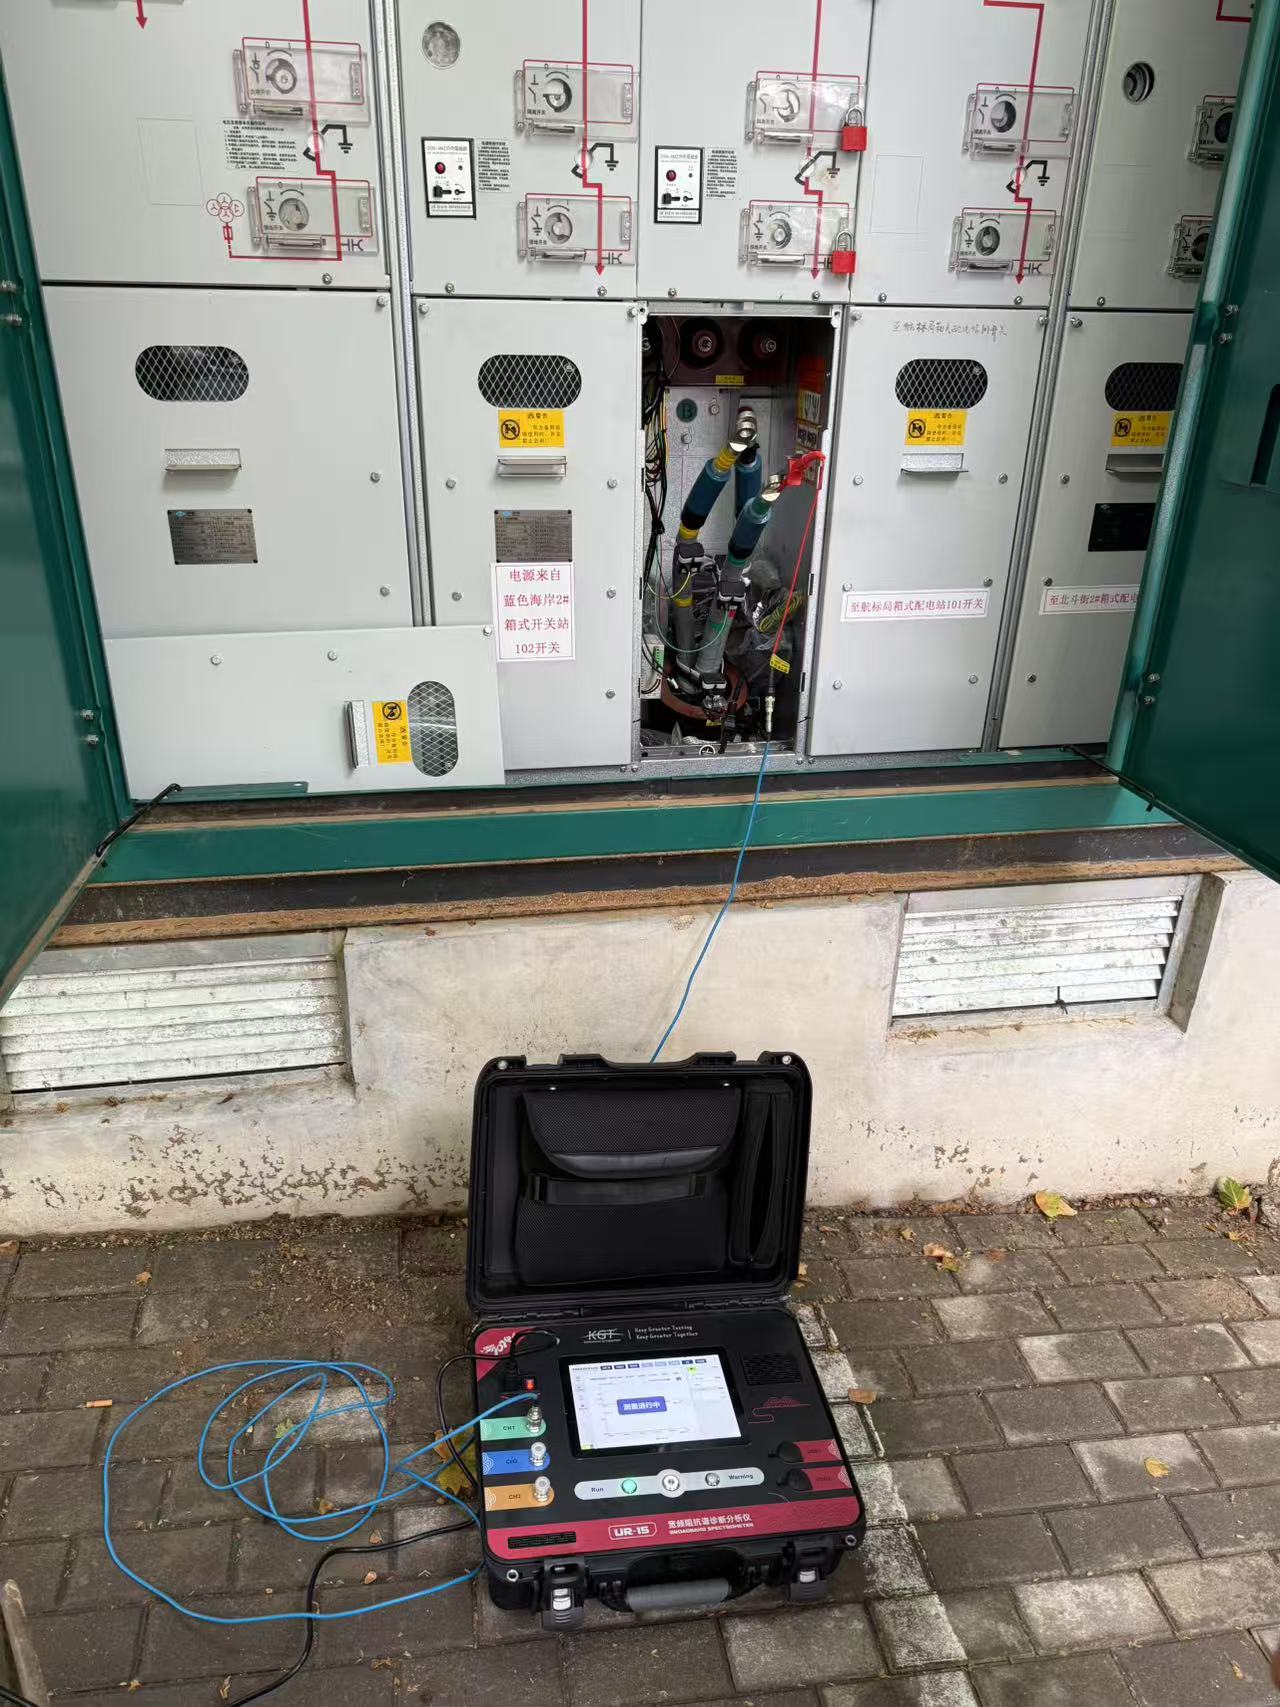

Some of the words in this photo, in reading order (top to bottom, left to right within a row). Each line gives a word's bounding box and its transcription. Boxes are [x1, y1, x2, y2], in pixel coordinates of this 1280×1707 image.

[509, 569, 561, 582] 电源来自
[503, 593, 570, 608] 蓝色海岸2#
[850, 598, 984, 613] 至航标局箱式配电站101开关
[504, 617, 569, 631] 箱式开关站
[515, 641, 561, 655] 102开关
[588, 1328, 616, 1340] KGT
[728, 1473, 754, 1481] Warning
[667, 1513, 753, 1529] 宽频阻抗谱诊断分析仪
[613, 1525, 651, 1537] UR-15
